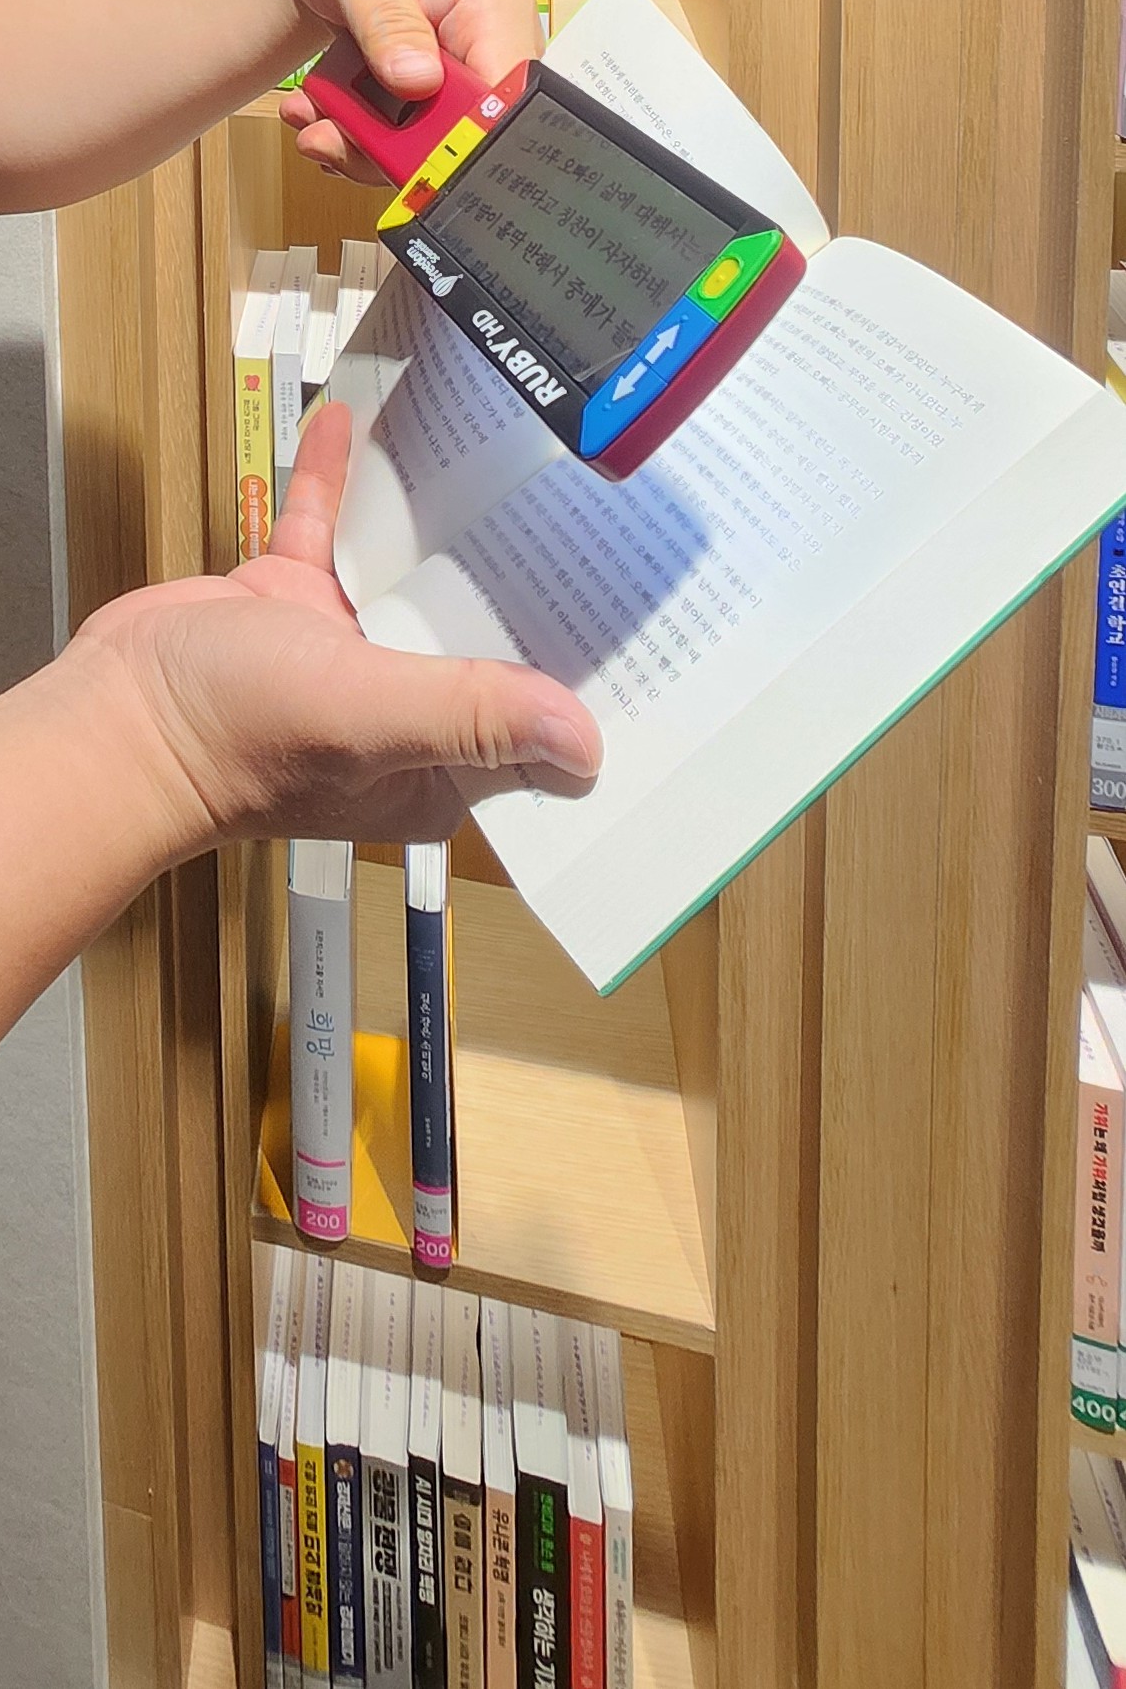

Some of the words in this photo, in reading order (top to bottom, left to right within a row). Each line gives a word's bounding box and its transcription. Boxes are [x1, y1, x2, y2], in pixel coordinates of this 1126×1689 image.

[506, 171, 561, 218] 잘한다고
[554, 205, 605, 250] 칭찬이
[520, 136, 537, 154] 그
[535, 142, 563, 168] 이후
[557, 153, 604, 191] 오빠의
[599, 178, 637, 214] 삶에
[632, 200, 702, 261] 대해서는
[406, 247, 442, 282] Freedom
[493, 218, 527, 251] 홀딱
[519, 238, 571, 287] 반해서
[558, 274, 619, 333] 중매가
[472, 310, 504, 338] HD
[489, 338, 567, 407] RUBY
[249, 479, 258, 495] 나는
[306, 1008, 336, 1060] 희망
[1094, 1102, 1109, 1138] 가위는
[1094, 1140, 1108, 1153] 왜
[1092, 1155, 1107, 1204] 가위처럼
[306, 1210, 340, 1231] 200
[1091, 1207, 1106, 1253] 생겼을까
[416, 1238, 449, 1258] 200
[1072, 1393, 1116, 1423] 400
[415, 1475, 432, 1494] AI
[416, 1495, 433, 1530] 시대
[491, 1508, 511, 1554] 유니콘
[373, 1523, 398, 1579] 전쟁
[416, 1526, 434, 1574] 일자리
[492, 1555, 511, 1585] 혁명
[418, 1573, 435, 1607] 혁명
[531, 1587, 557, 1659] 생각하는
